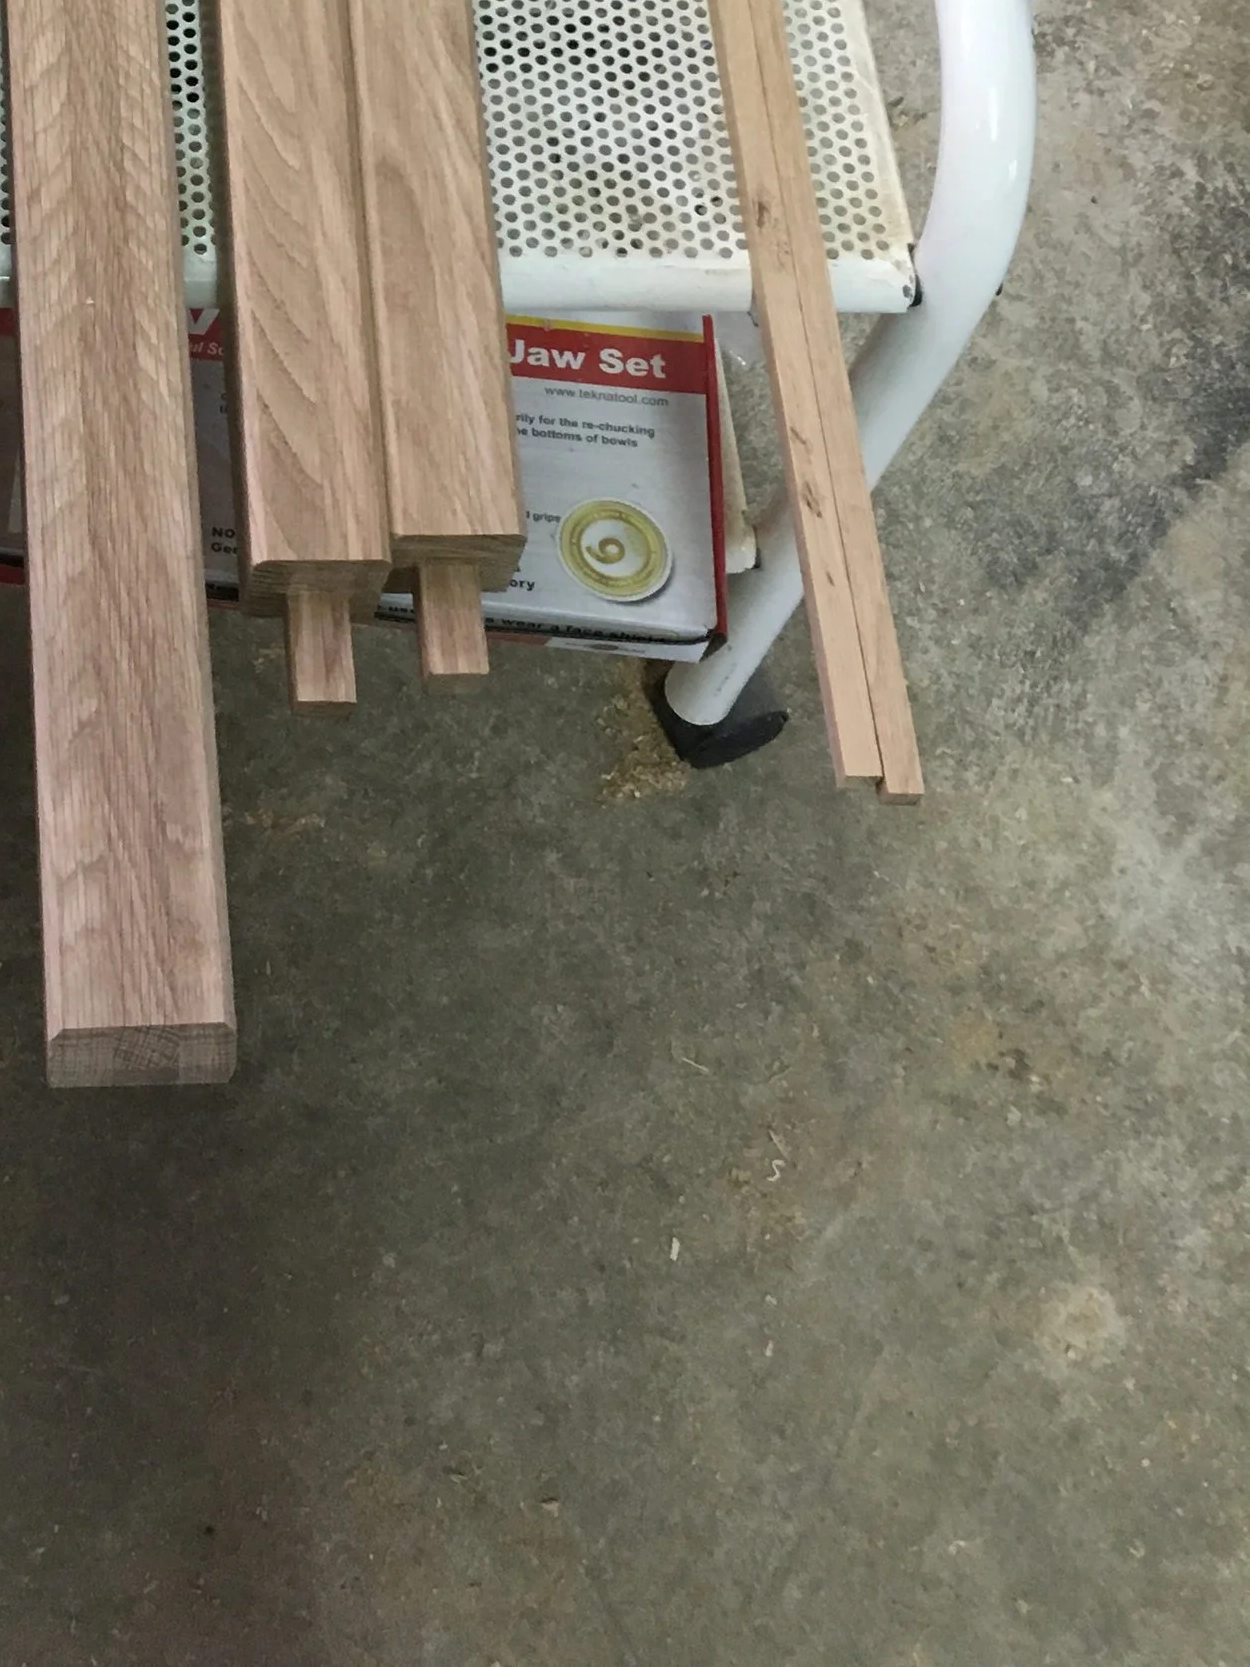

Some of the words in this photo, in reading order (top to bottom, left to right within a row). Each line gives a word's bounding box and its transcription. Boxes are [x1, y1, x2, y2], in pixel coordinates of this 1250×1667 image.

[509, 339, 586, 370] Jaw
[599, 348, 666, 379] Set
[544, 387, 669, 407] www.teknatool.com
[531, 428, 582, 441] bottoms
[585, 435, 598, 444] of
[601, 436, 638, 448] bowls
[538, 415, 556, 426] for
[559, 418, 579, 428] the
[582, 421, 655, 439] re-chucking
